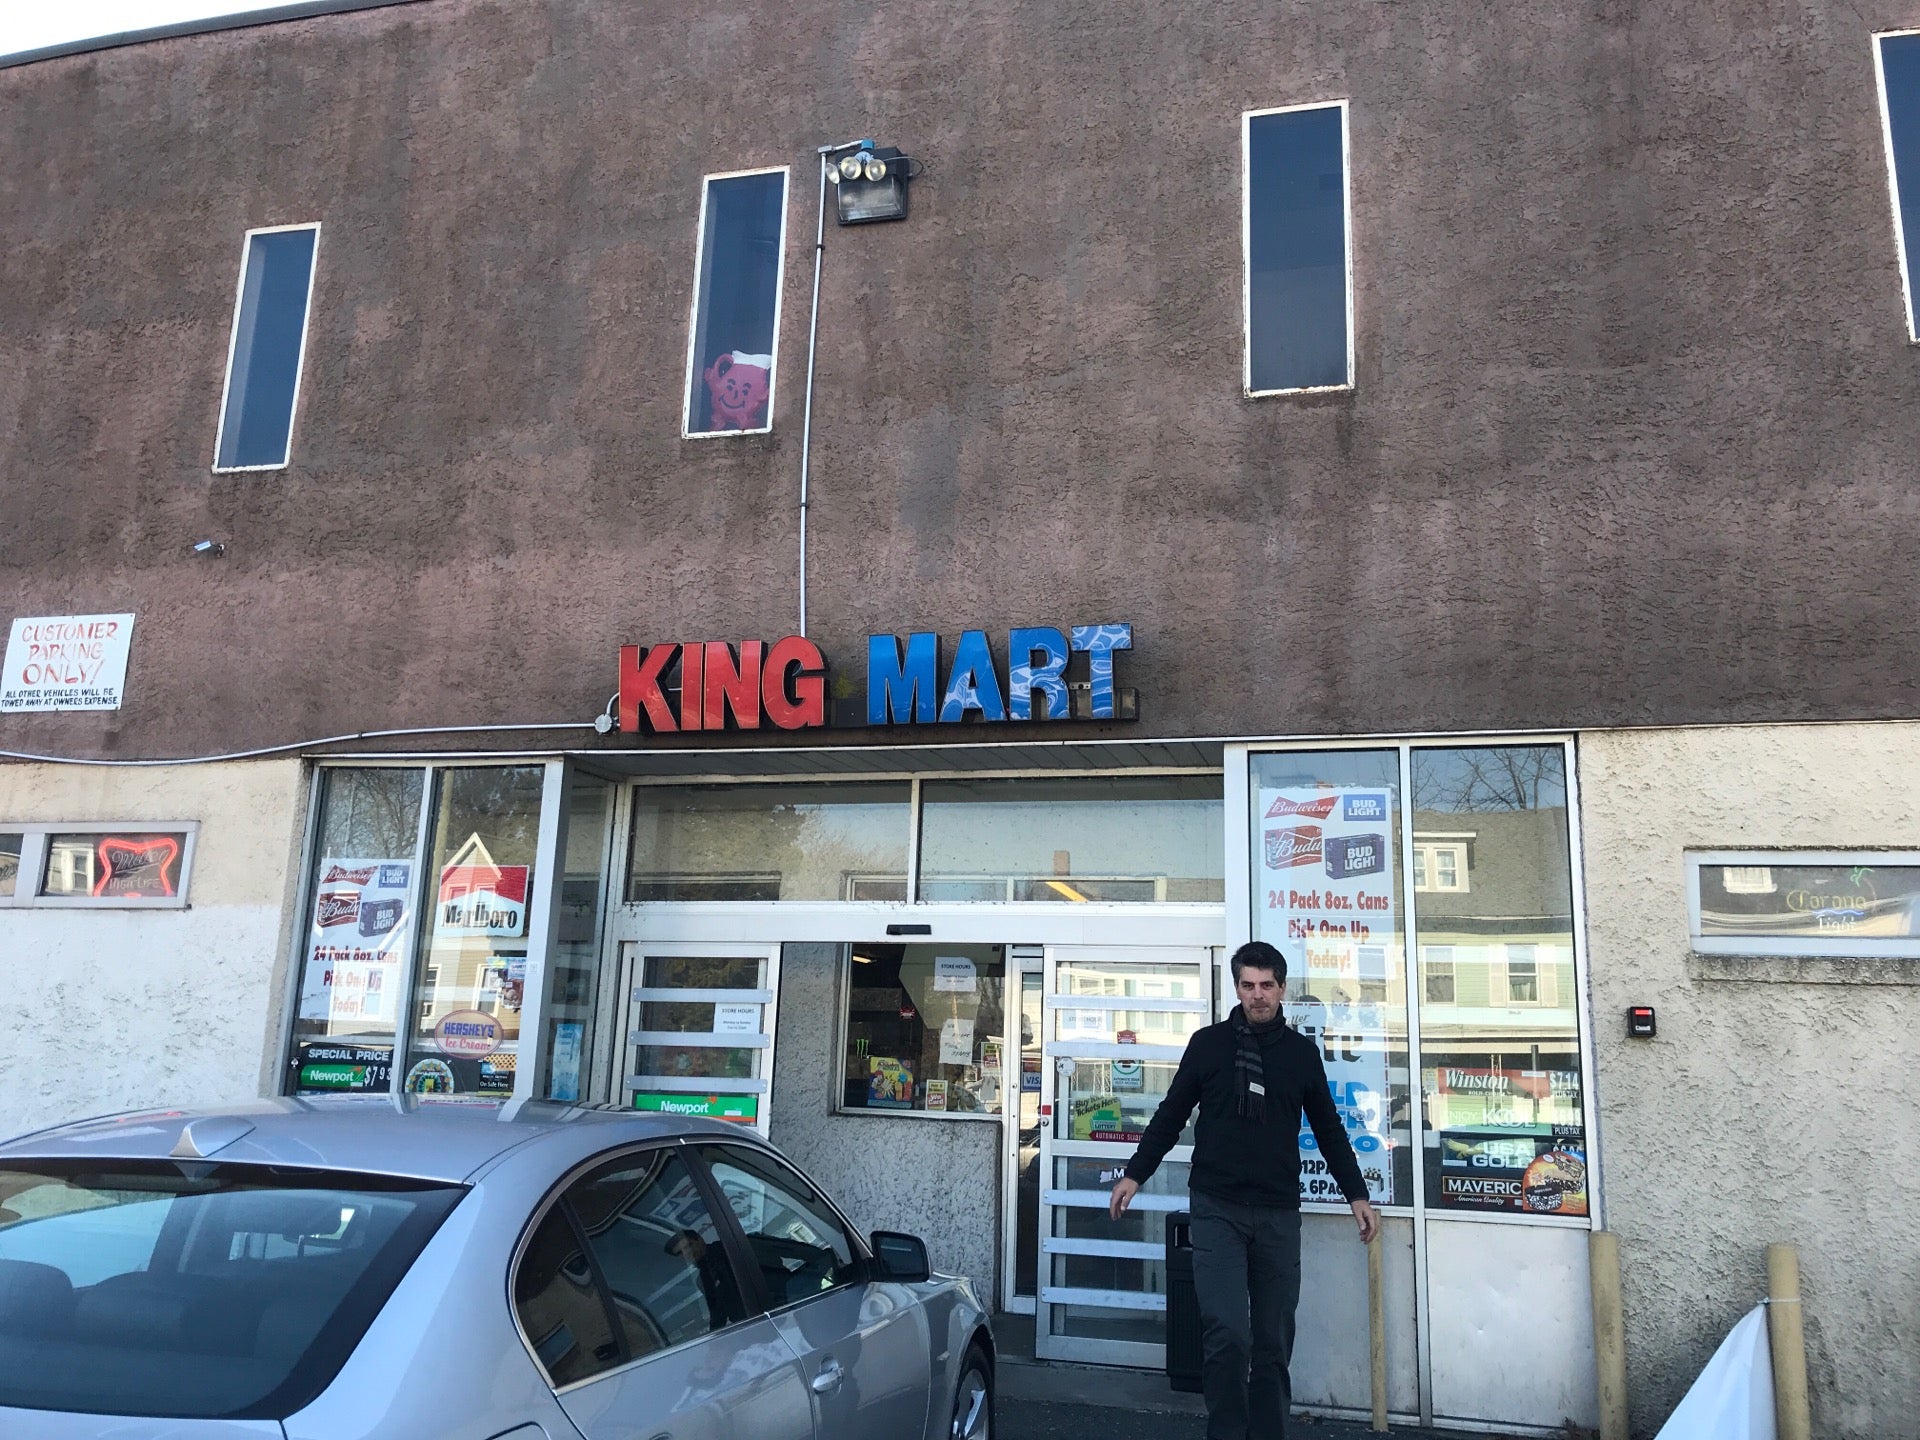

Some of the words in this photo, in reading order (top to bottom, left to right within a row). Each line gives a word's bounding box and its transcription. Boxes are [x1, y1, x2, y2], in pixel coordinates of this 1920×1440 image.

[22, 622, 118, 642] CUSTOMER
[29, 642, 104, 662] PARKING
[22, 659, 105, 685] ONLY!
[620, 635, 825, 733] KING
[867, 622, 1132, 726] MART
[5, 690, 17, 698] ALL
[18, 690, 41, 698] OTHER
[43, 689, 79, 697] VEHICLES
[81, 688, 100, 696] WILL
[103, 688, 114, 696] BE
[1, 699, 24, 707] TOWED
[53, 698, 83, 706] OWNERS
[84, 697, 118, 705] EXPENSE
[1271, 800, 1333, 814] Budweiser
[1352, 799, 1376, 808] BUD
[1348, 807, 1381, 816] LIGHT
[1347, 846, 1373, 859] BUD
[1344, 856, 1376, 870] LIGHT
[327, 869, 372, 880] Budweiser
[381, 876, 405, 884] LIGHT
[386, 869, 402, 877] BUD
[1268, 890, 1285, 909] 24
[1289, 889, 1320, 910] Pack
[1325, 890, 1353, 910] 8oz.
[1357, 891, 1389, 910] Cans
[376, 910, 394, 920] BUD
[441, 901, 517, 929] Marlboro
[373, 918, 395, 930] LIGHT
[1320, 919, 1347, 939] One
[1351, 920, 1370, 944] Up
[313, 945, 327, 961] 24
[328, 945, 350, 961] Pack
[353, 947, 374, 961] 8oz.
[376, 949, 398, 963] Cans
[1306, 949, 1351, 973] Today!
[1287, 1014, 1310, 1025] ller
[444, 1022, 494, 1037] HERSHEY'S
[445, 1036, 458, 1048] Ice
[460, 1039, 490, 1051] Cream
[308, 1048, 353, 1060] SPECIAL
[355, 1050, 390, 1061] PRICE
[310, 1069, 354, 1084] Newport
[1026, 1076, 1041, 1085] VIS
[1445, 1068, 1509, 1089] Winston
[660, 1101, 709, 1115] Newport
[1076, 1098, 1089, 1108] Buy
[1076, 1103, 1101, 1116] Tickets
[1101, 1097, 1120, 1107] Here
[1448, 1110, 1478, 1123] NJOY
[1481, 1108, 1536, 1128] KOOL
[1095, 1132, 1125, 1140] AUTOMATIC
[1127, 1133, 1143, 1141] SLIDI
[1554, 1127, 1569, 1135] PLUS
[1570, 1127, 1580, 1135] TAX
[1483, 1141, 1531, 1156] USA
[1472, 1154, 1533, 1168] GOLD
[1309, 1179, 1345, 1195] 6PAC
[1448, 1179, 1522, 1195] MAVERIC
[1454, 1195, 1482, 1203] American
[1483, 1195, 1505, 1205] Quality
